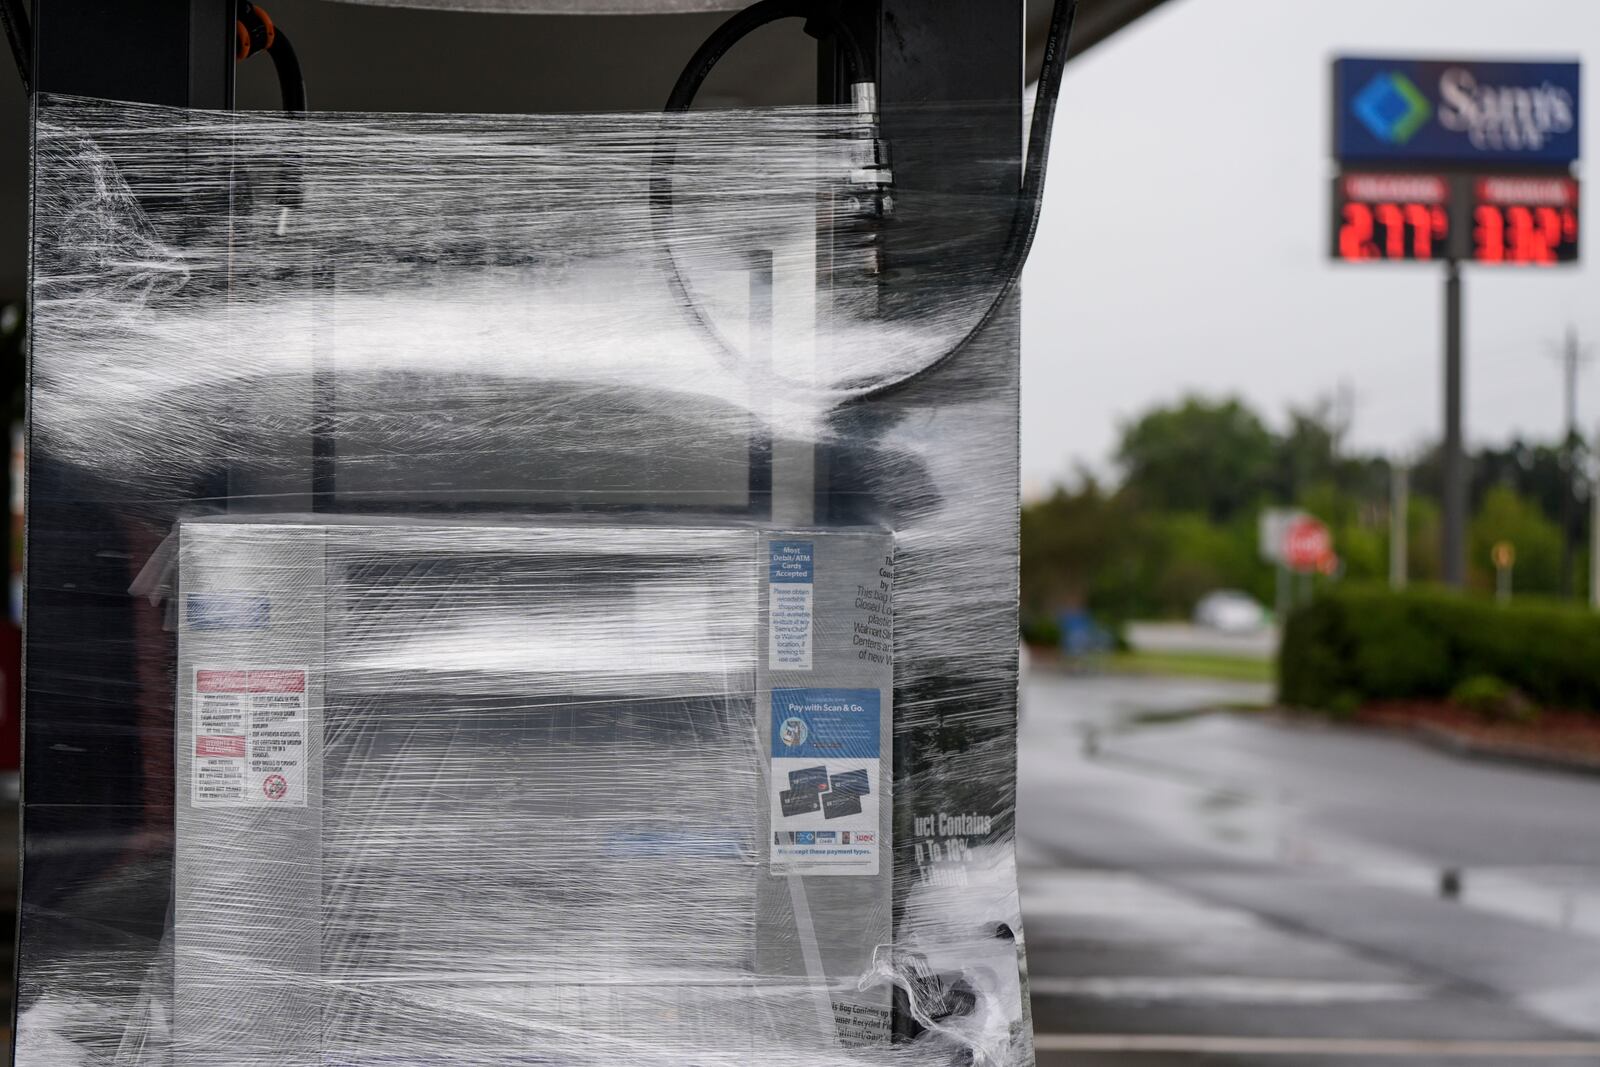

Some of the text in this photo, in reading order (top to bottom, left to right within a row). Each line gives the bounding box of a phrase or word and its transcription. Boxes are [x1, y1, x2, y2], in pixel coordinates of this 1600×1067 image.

[789, 704, 864, 713] Pay with Scan & Go.
[939, 812, 992, 836] Contains
[926, 840, 942, 862] To
[880, 1010, 889, 1020] up
